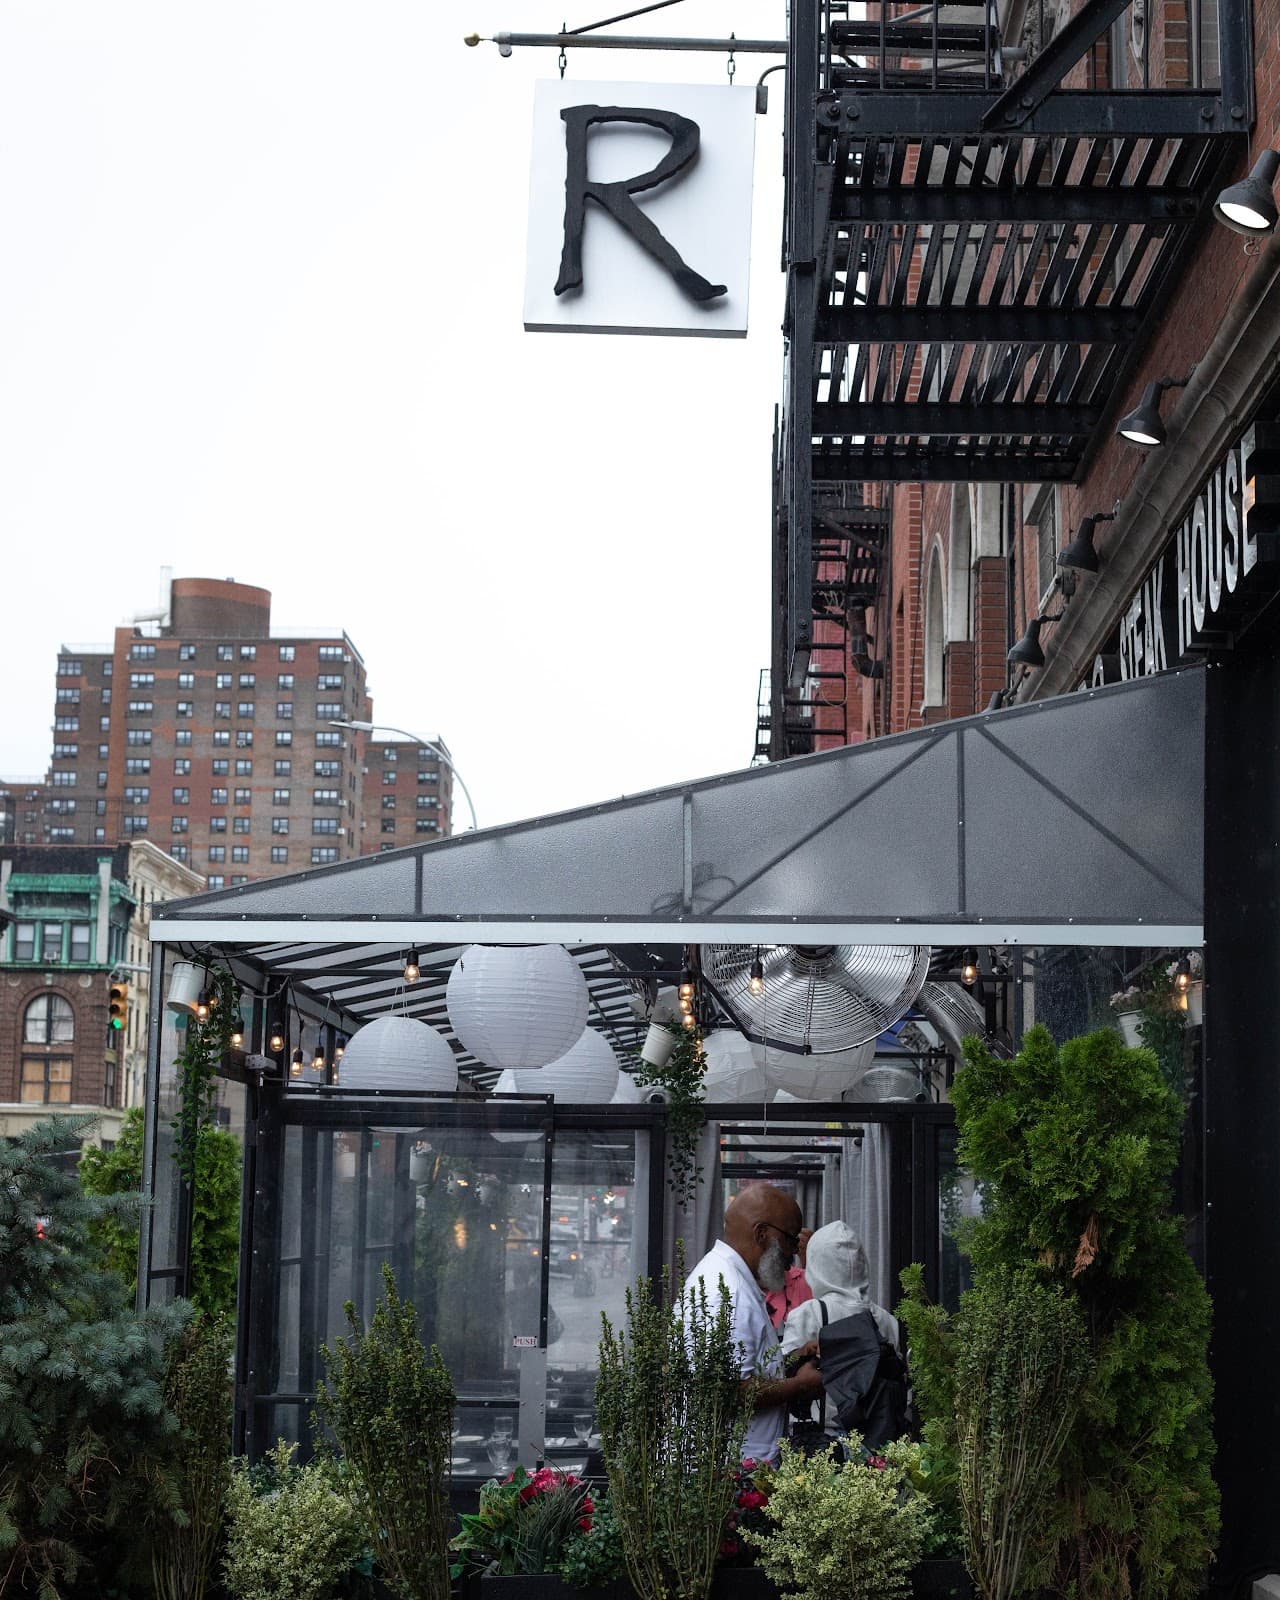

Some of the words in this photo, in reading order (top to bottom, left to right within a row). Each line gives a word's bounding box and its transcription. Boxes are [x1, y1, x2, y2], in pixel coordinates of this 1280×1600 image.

[553, 103, 728, 301] R
[1176, 421, 1258, 658] HOUSE
[514, 1337, 537, 1346] PUSH
